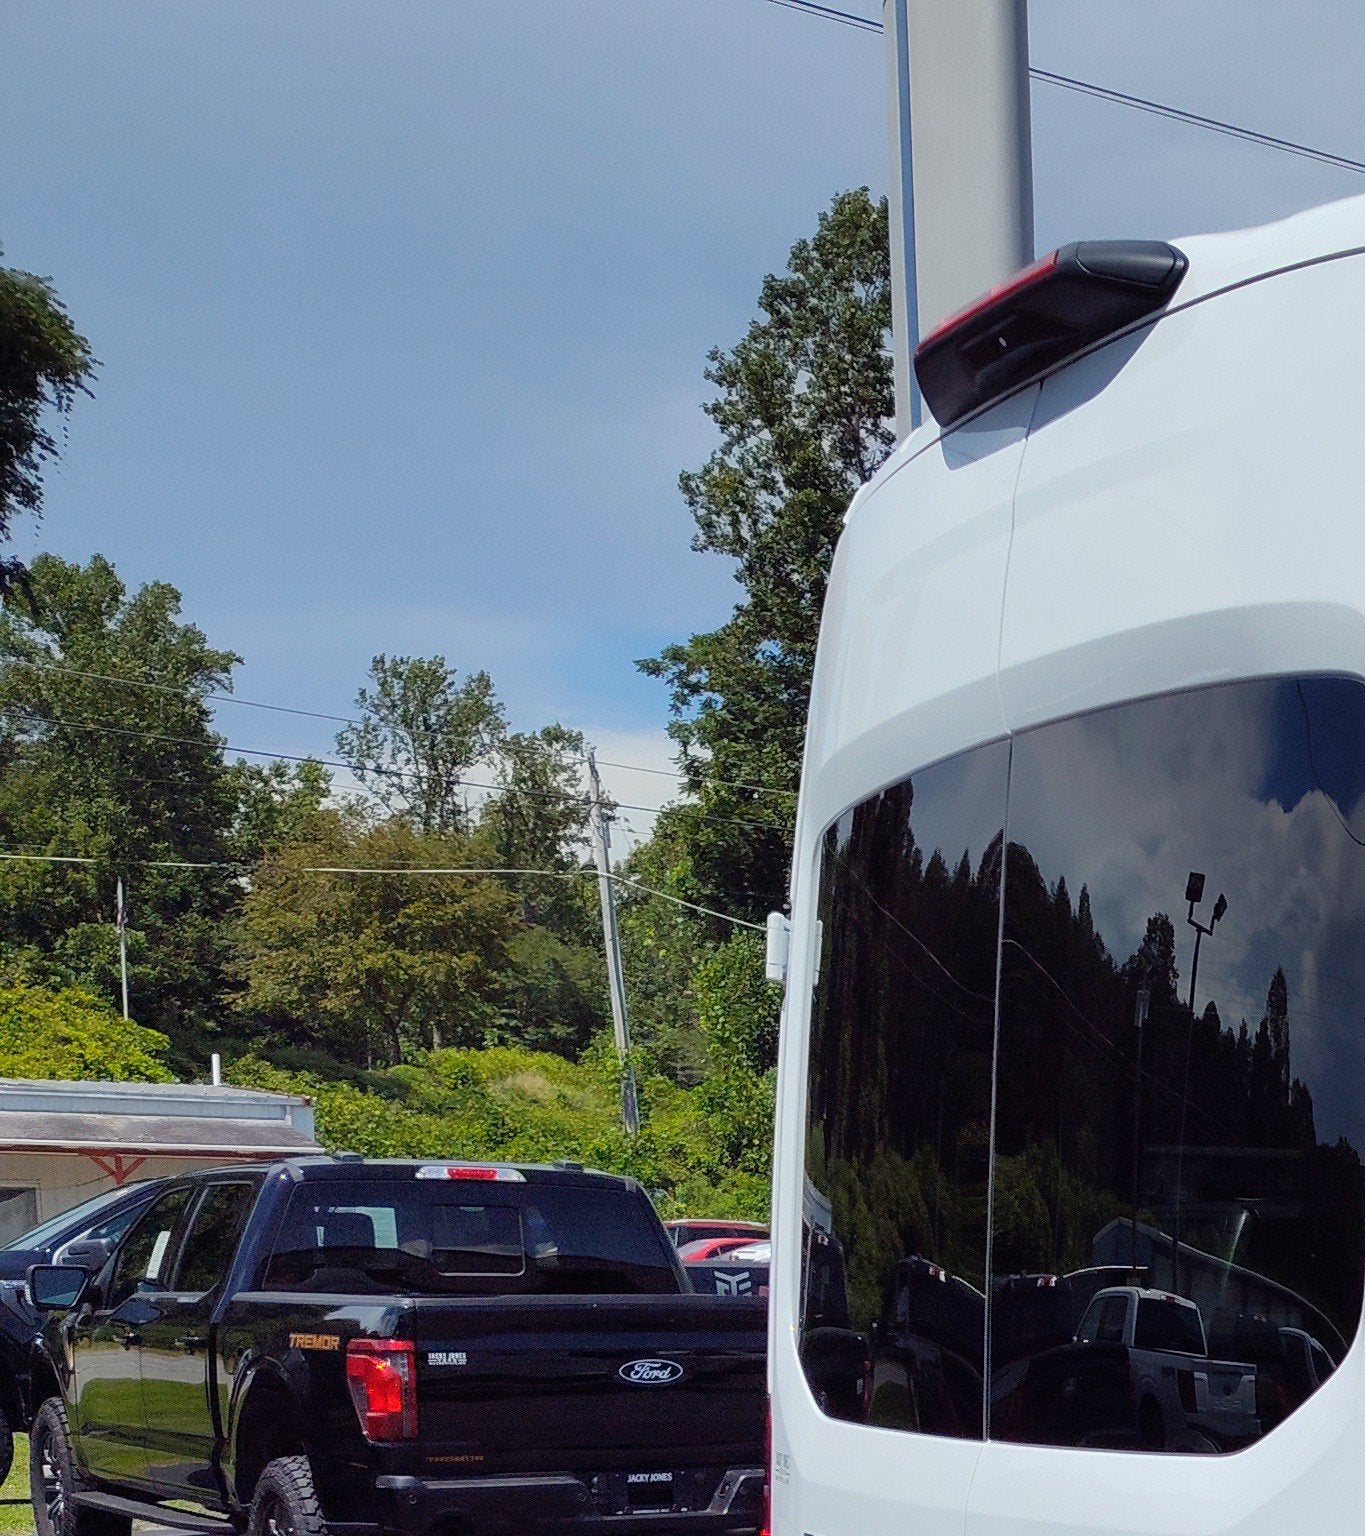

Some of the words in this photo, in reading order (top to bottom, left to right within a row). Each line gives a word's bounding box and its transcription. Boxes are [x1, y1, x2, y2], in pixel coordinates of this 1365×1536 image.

[289, 1332, 341, 1350] TREMOR
[630, 1362, 671, 1379] Ford
[650, 1472, 673, 1482] JONES
